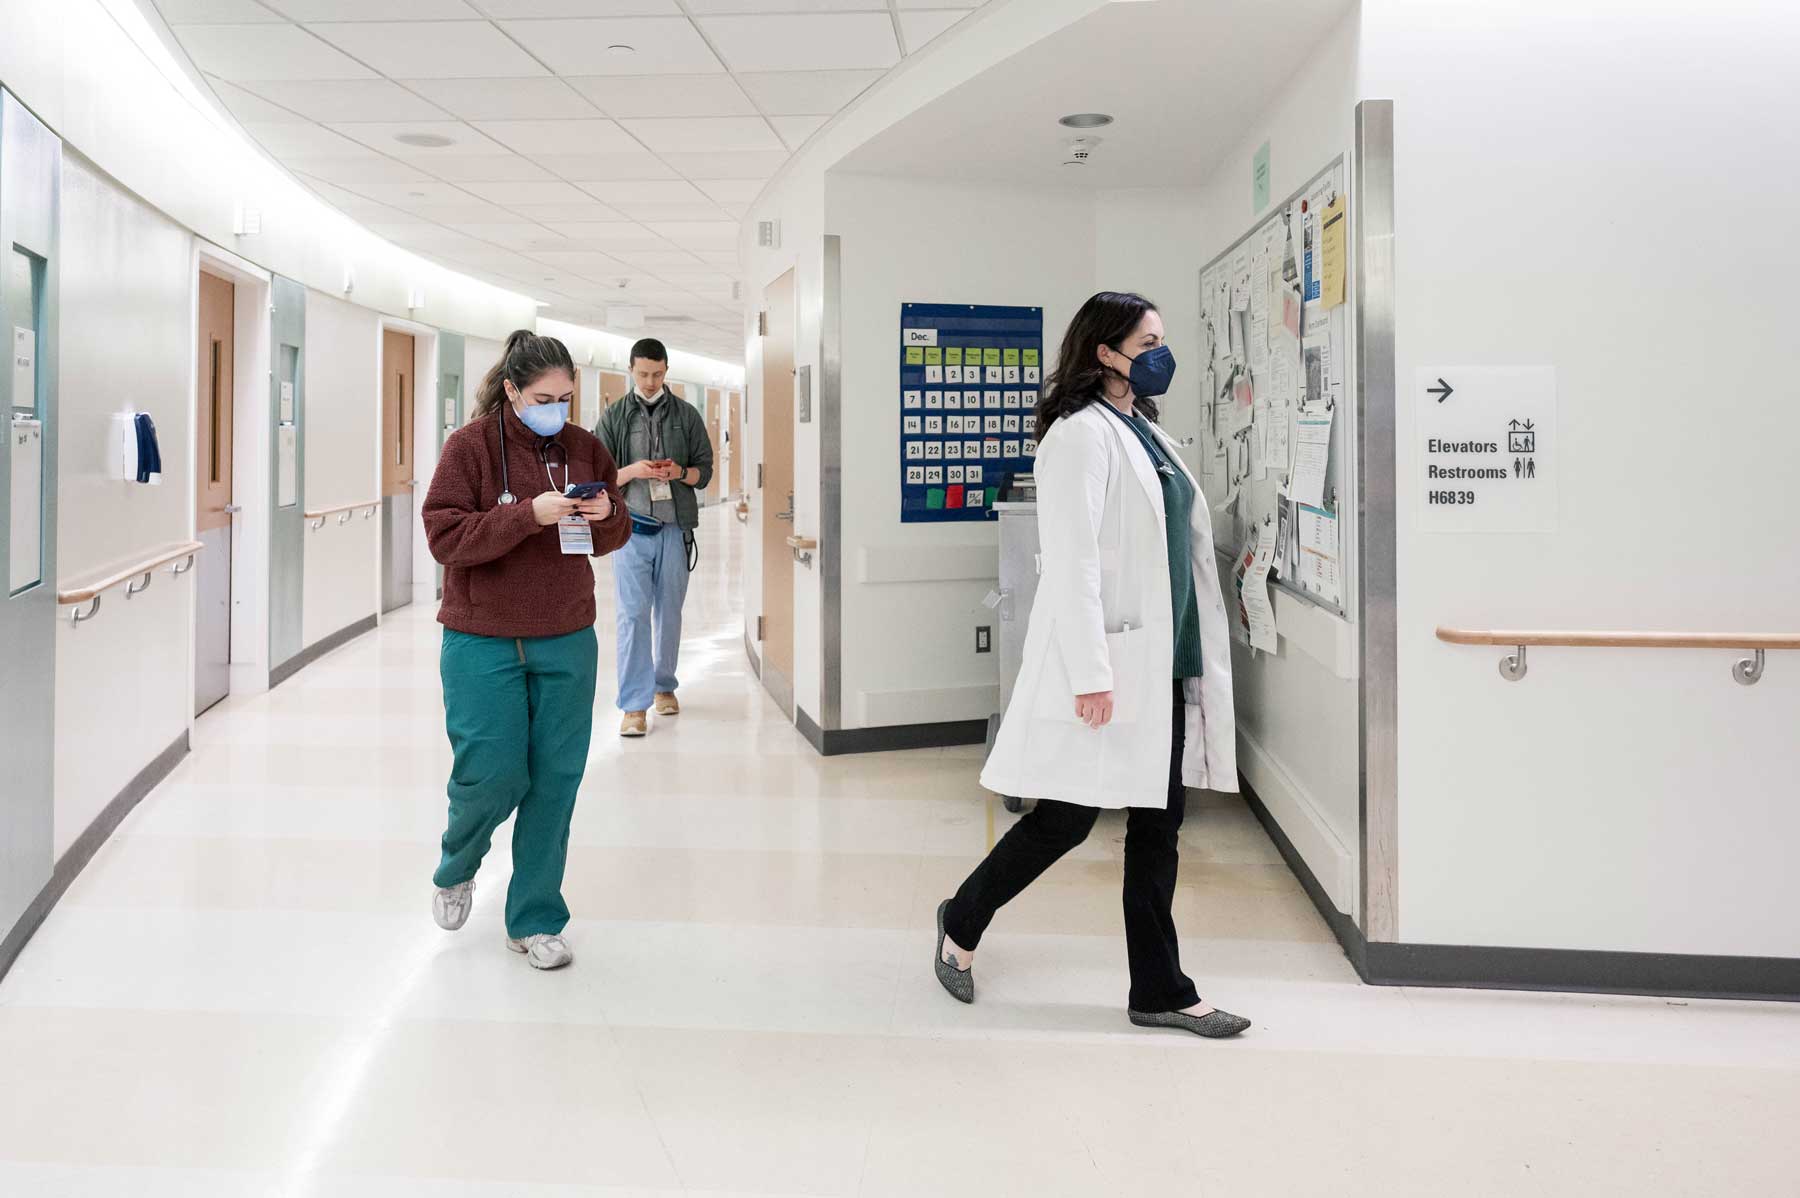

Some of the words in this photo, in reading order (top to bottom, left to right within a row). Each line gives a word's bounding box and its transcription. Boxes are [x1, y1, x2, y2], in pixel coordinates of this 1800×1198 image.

[911, 332, 929, 341] Dec.
[951, 370, 956, 379] 2
[969, 370, 975, 379] 3
[1009, 370, 1015, 379] 5
[1029, 371, 1034, 379] 6
[910, 395, 915, 403] 7
[931, 395, 936, 404] 8
[950, 396, 956, 404] 9
[967, 395, 976, 404] 10
[989, 395, 995, 404] 11
[1007, 395, 1016, 404] 12
[929, 420, 938, 429] 15
[950, 420, 959, 429] 16
[967, 420, 976, 429] 17
[988, 420, 997, 429] 18
[1007, 419, 1016, 428] 19
[1025, 420, 1036, 428] 20
[910, 446, 920, 455] 21
[928, 446, 939, 455] 22
[948, 446, 959, 454] 23
[966, 445, 977, 454] 24
[986, 445, 998, 454] 25
[1006, 445, 1017, 454] 26
[1025, 443, 1036, 452] 27
[1428, 439, 1498, 453] Elevators
[910, 471, 921, 480] 28
[928, 471, 940, 479] 29
[950, 470, 961, 479] 30
[970, 470, 979, 479] 31
[1428, 464, 1507, 479] Restrooms
[1429, 490, 1475, 505] H6839
